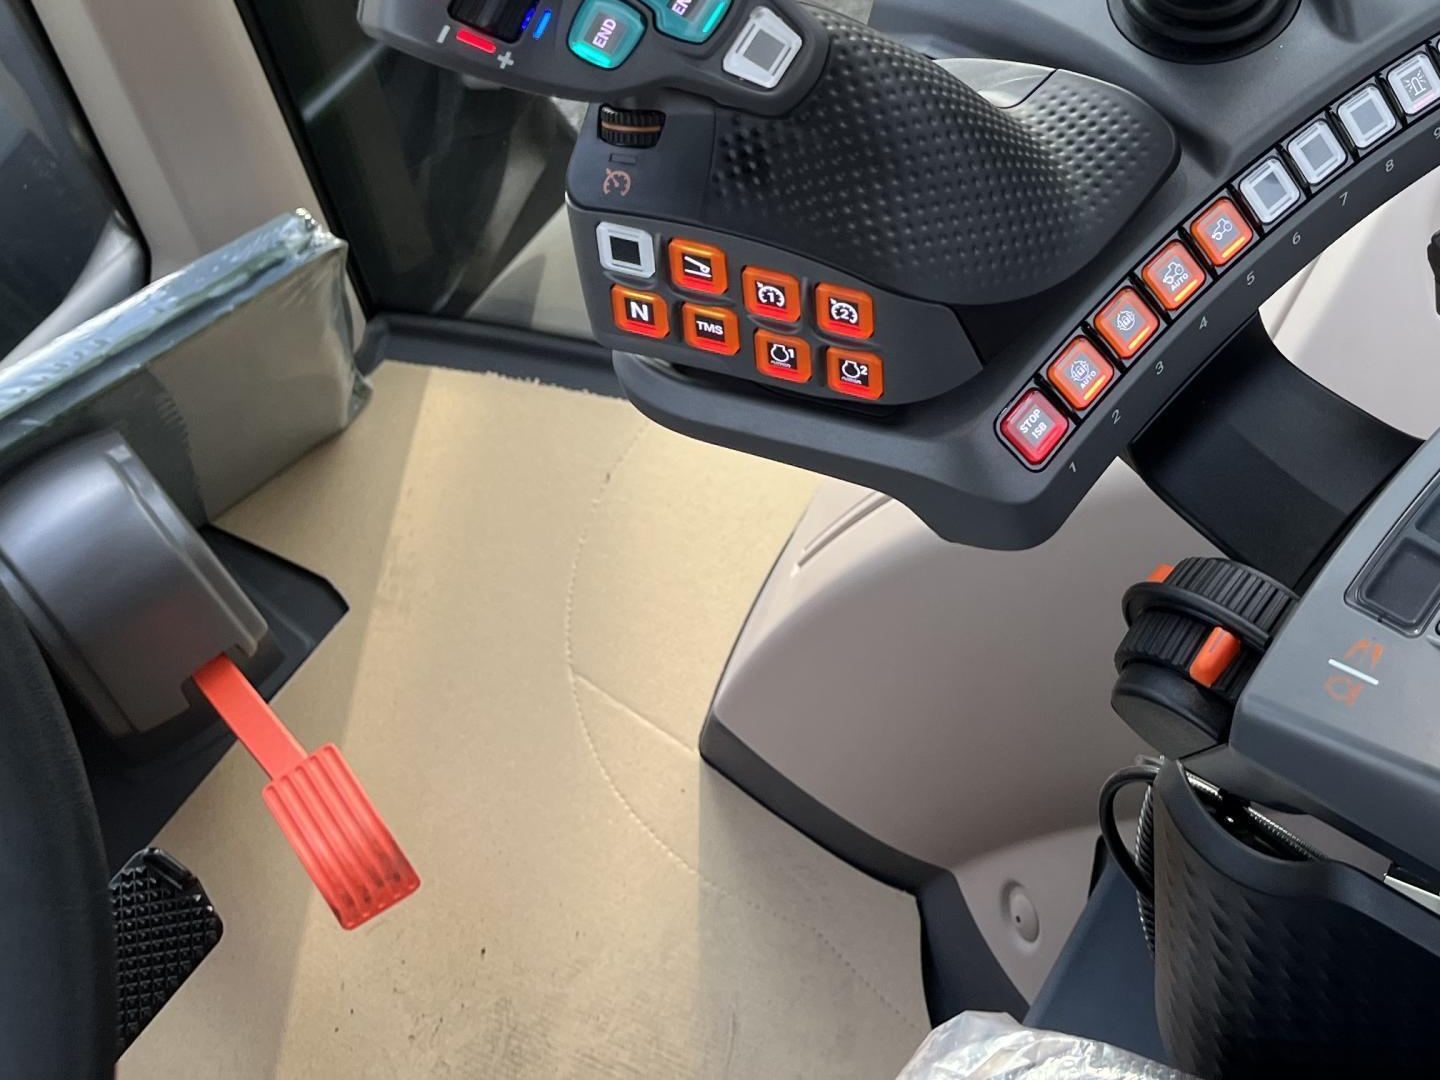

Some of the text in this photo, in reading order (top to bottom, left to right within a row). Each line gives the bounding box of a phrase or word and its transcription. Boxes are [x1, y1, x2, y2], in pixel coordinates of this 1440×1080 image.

[592, 18, 617, 49] END
[1385, 159, 1395, 173] 8
[1339, 192, 1349, 206] 7
[1292, 232, 1302, 245] 6
[1171, 272, 1189, 292] AUTO
[1246, 271, 1256, 286] 5
[630, 301, 649, 322] N
[696, 320, 724, 336] TMS
[1199, 317, 1208, 330] 4
[1154, 360, 1164, 375] 3
[1080, 370, 1097, 389] AUTO
[1019, 408, 1041, 434] STOP
[1111, 409, 1121, 424] 2
[1031, 422, 1047, 439] ISB
[1069, 461, 1077, 473] 1
